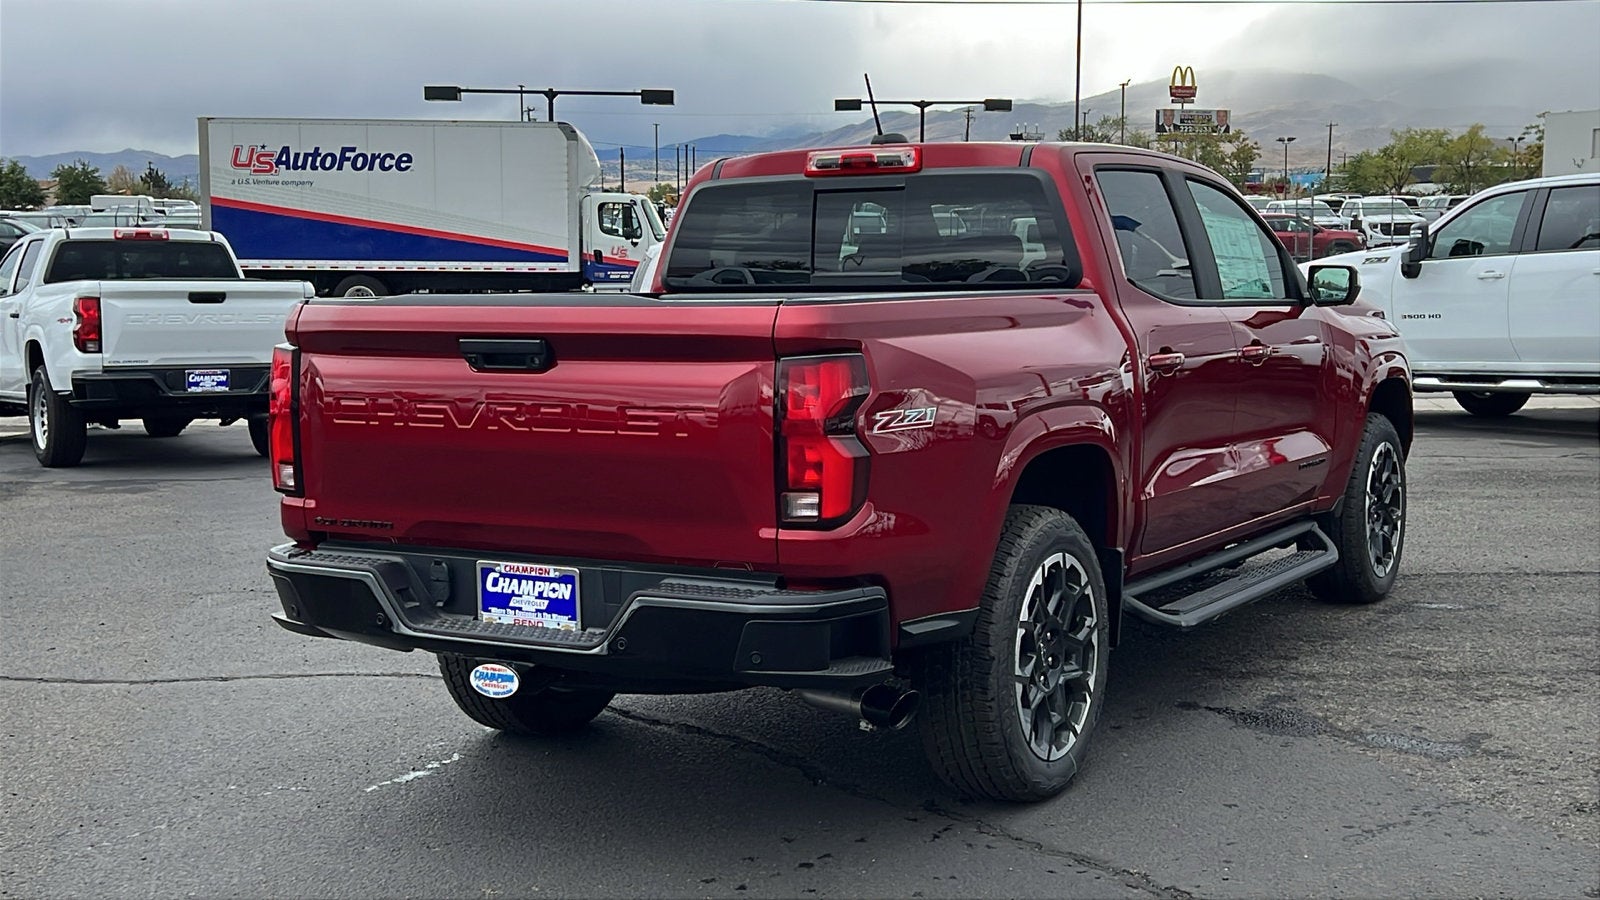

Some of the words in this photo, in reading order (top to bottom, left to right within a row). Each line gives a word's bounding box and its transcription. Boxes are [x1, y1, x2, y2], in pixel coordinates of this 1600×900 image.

[275, 146, 413, 172] AutoForce
[237, 178, 251, 186] U.S.
[281, 180, 314, 188] company
[126, 312, 287, 326] CHEVROLET
[188, 373, 228, 383] CHAMPION
[332, 396, 706, 438] CHEVROLET
[873, 406, 937, 434] Z71
[504, 565, 550, 576] CHAMPION
[485, 572, 572, 600] CHAMPION
[512, 598, 546, 607] CHEVROLET
[513, 618, 545, 627] RENO
[482, 682, 508, 690] CHEVROLET
